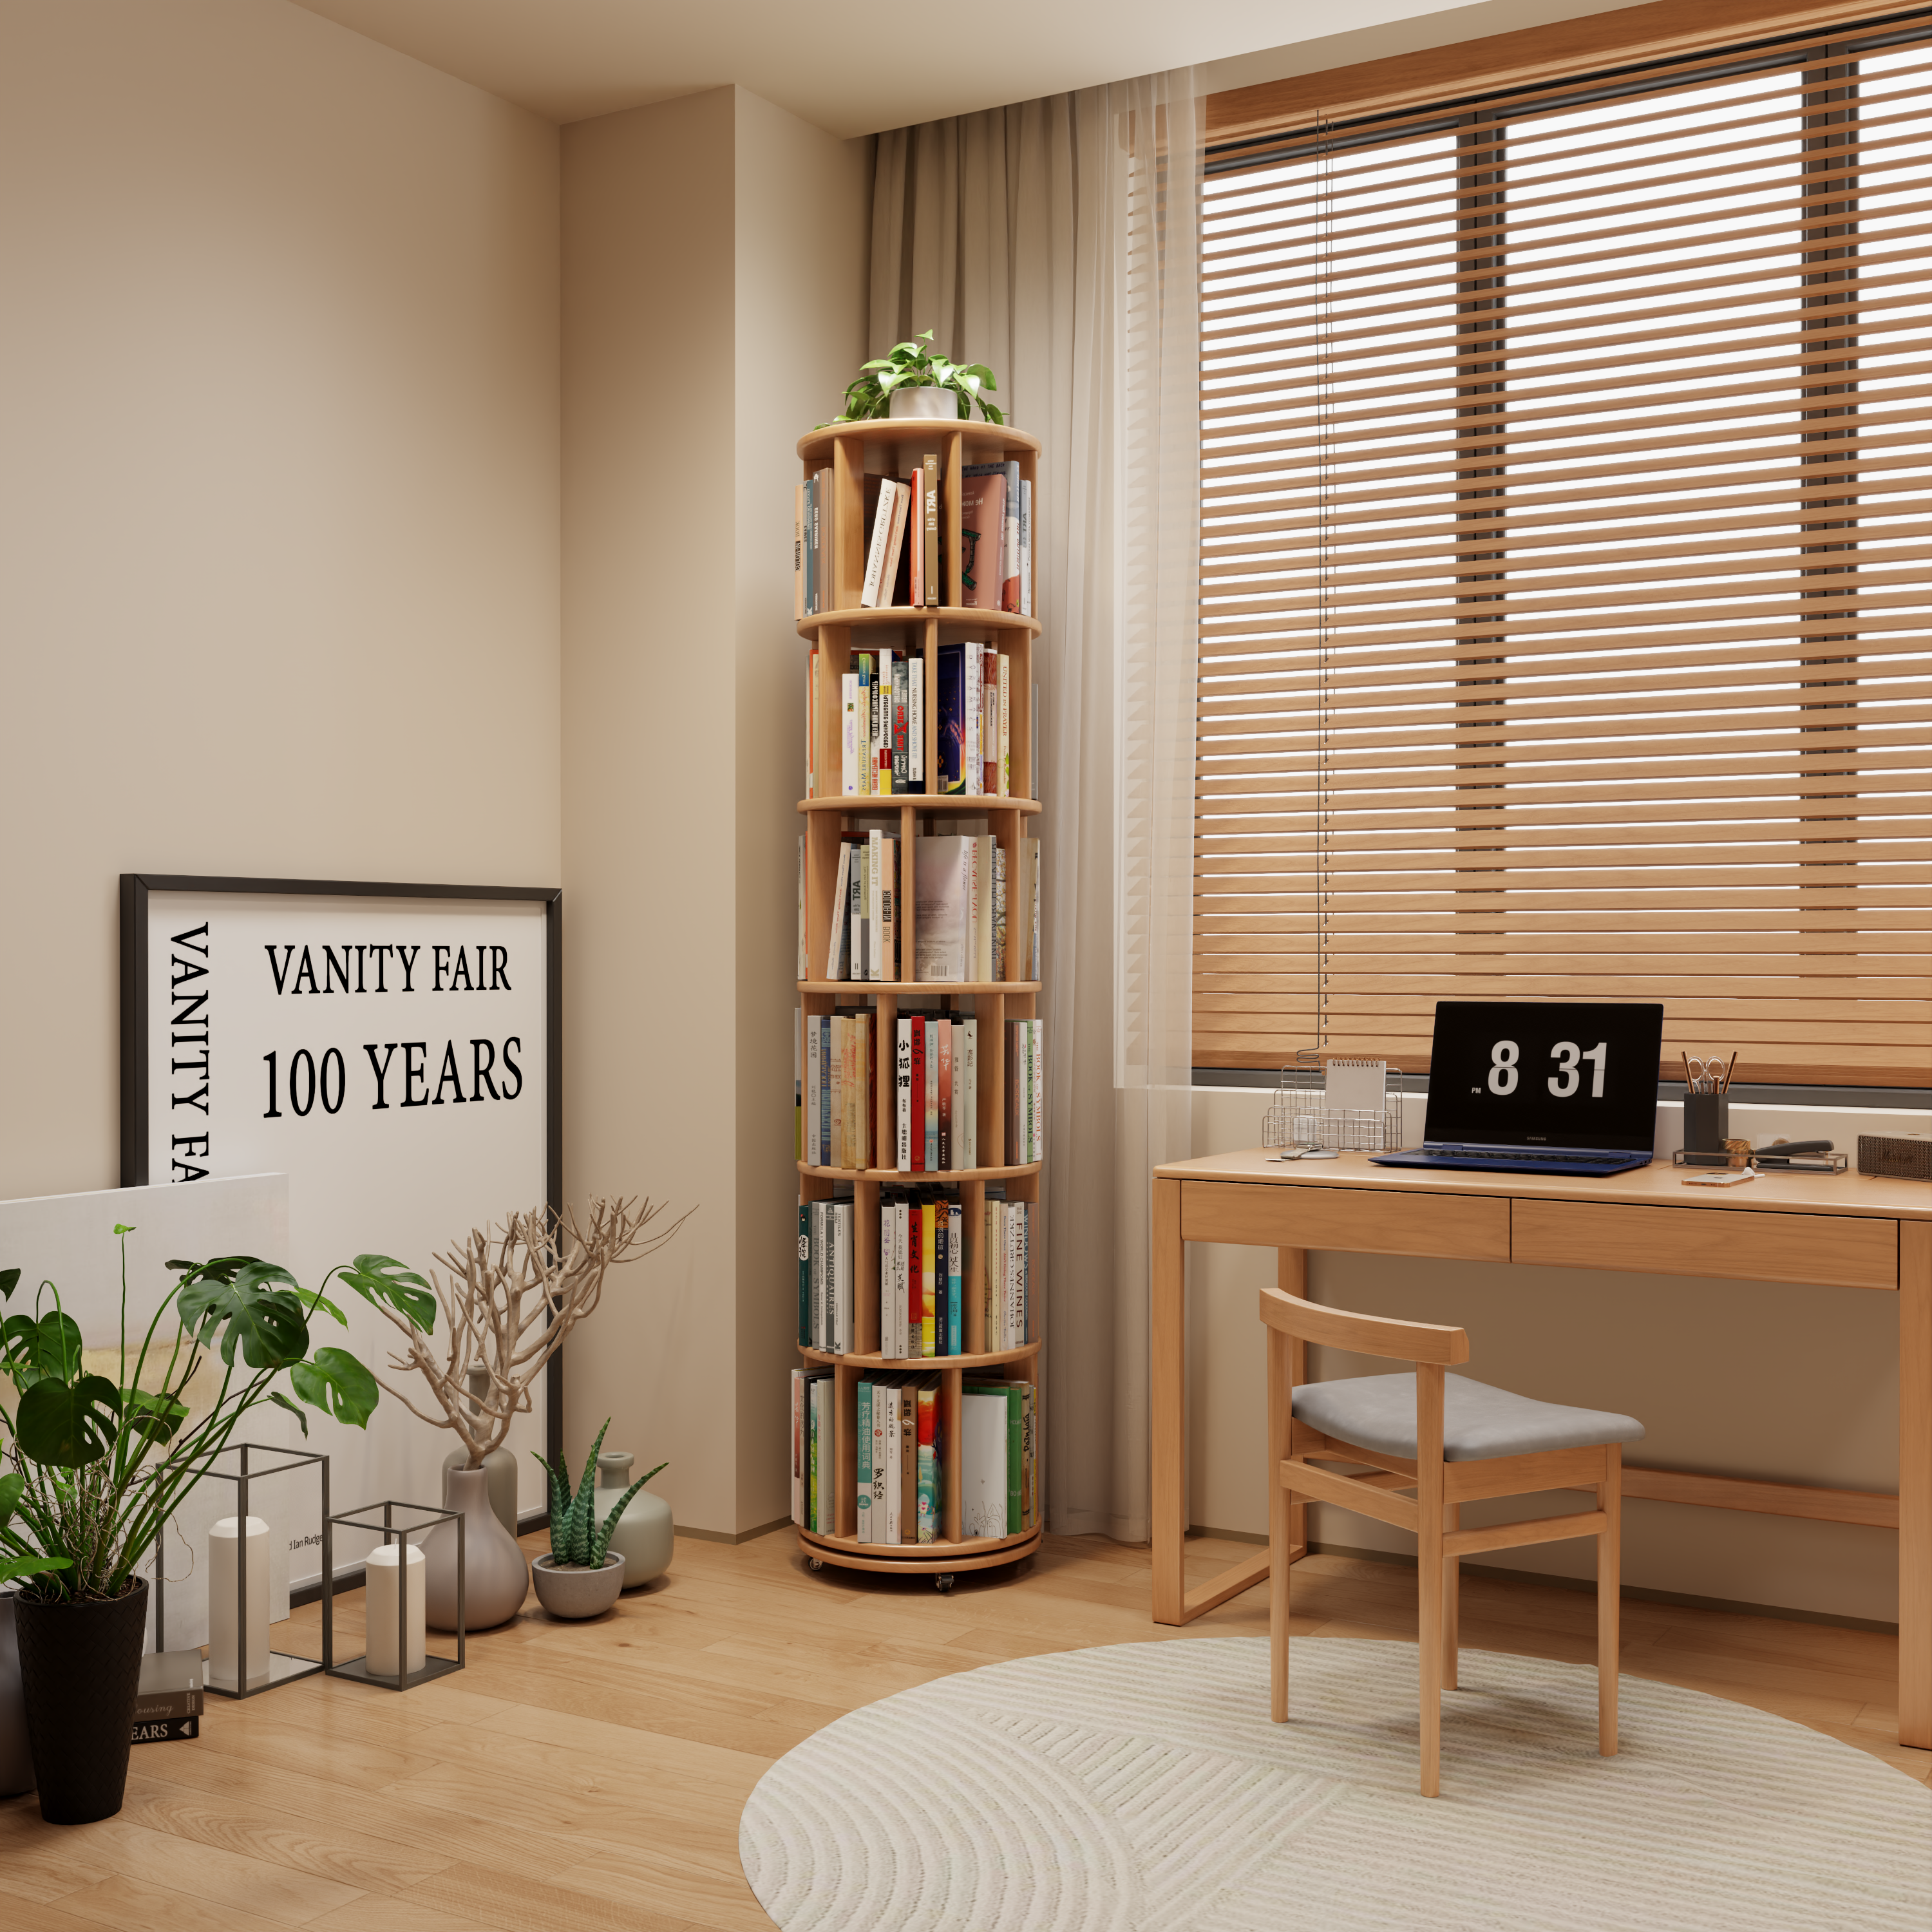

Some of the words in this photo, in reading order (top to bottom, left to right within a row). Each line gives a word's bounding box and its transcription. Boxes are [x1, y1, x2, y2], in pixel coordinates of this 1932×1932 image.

[871, 876, 878, 886] IT
[265, 943, 421, 996] VANITY
[431, 945, 512, 991] FAIR
[170, 921, 210, 1116] VANITY
[810, 1031, 818, 1059] 梦境花园
[898, 1039, 911, 1088] 小狐狸
[940, 1044, 951, 1071] 芳华
[1488, 1039, 1520, 1096] 8
[1547, 1041, 1607, 1098] 31
[263, 1047, 346, 1119] 100
[363, 1036, 523, 1110] YEARS
[910, 1221, 920, 1274] 生肖文化
[861, 1401, 871, 1470] 芳疗精油使用词典
[873, 1468, 885, 1500] 罗织经
[293, 1539, 303, 1549] Ian
[305, 1533, 323, 1546] Rudge
[135, 1705, 173, 1716] ousing
